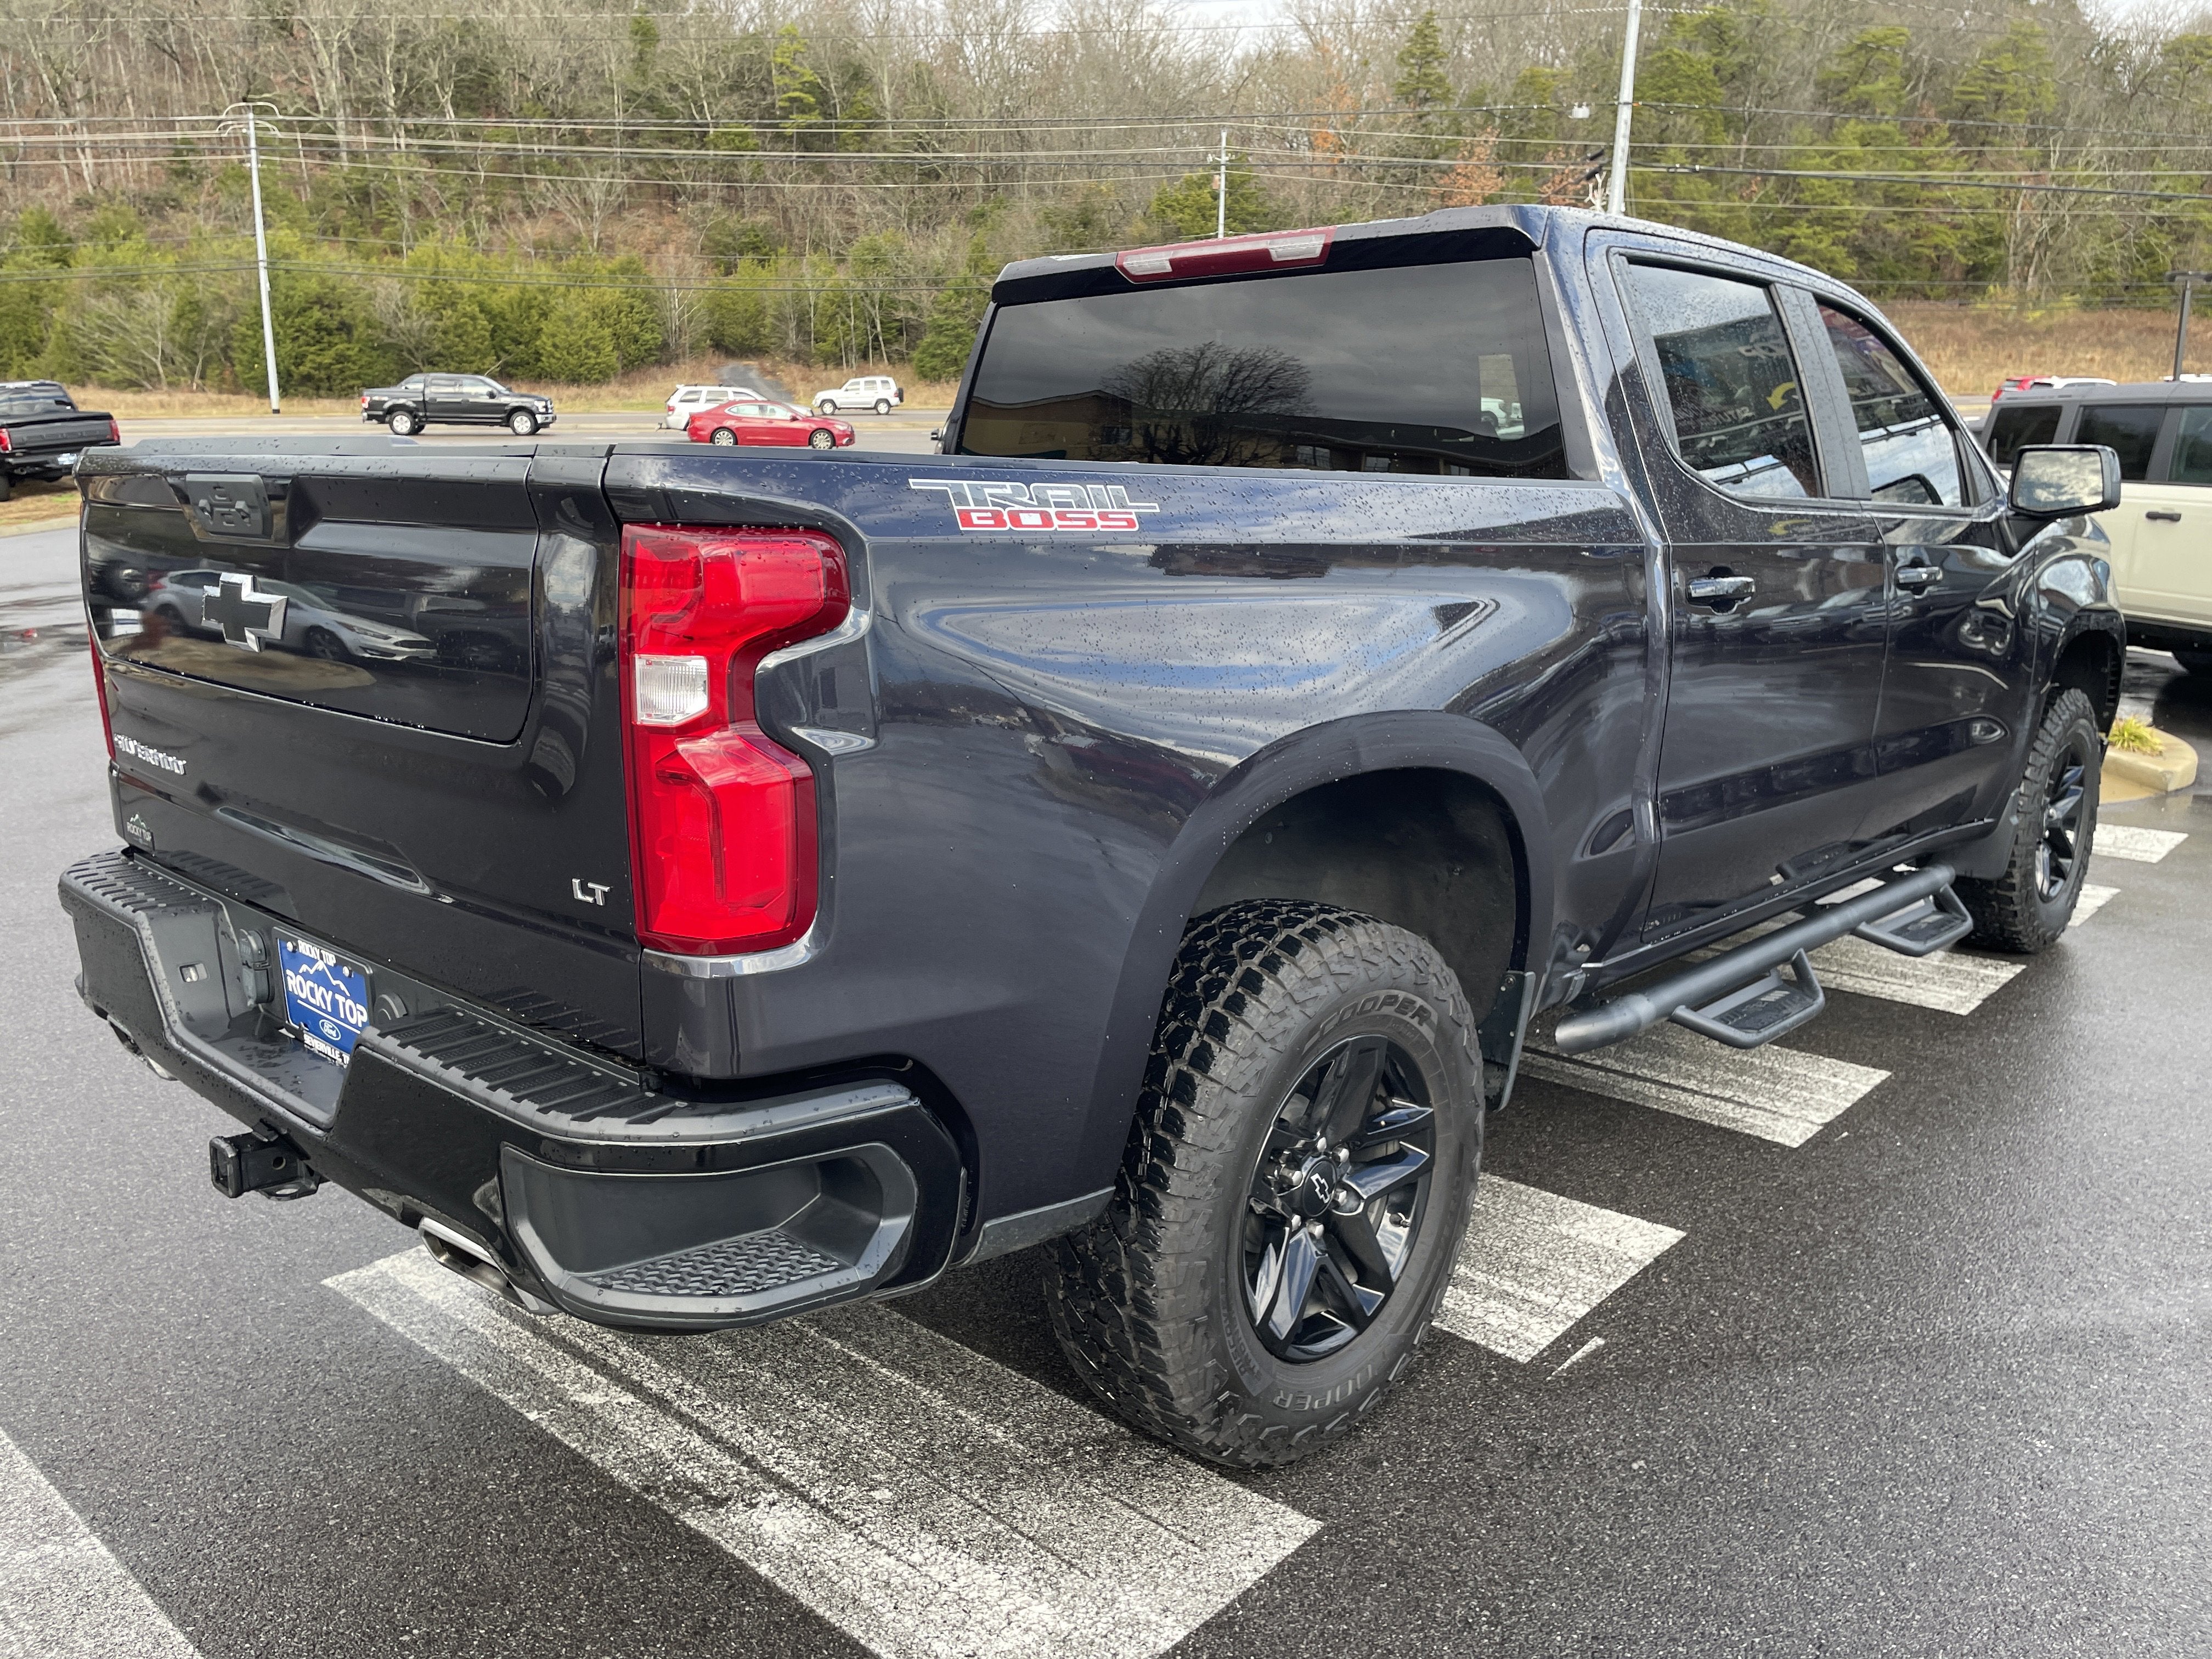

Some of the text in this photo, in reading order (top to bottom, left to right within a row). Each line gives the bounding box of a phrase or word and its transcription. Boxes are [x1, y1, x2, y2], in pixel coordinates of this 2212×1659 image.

[908, 477, 1160, 513] TRAIL
[955, 506, 1140, 531] BOSS
[572, 878, 611, 906] LT
[297, 939, 336, 967] ROCKY TOP
[286, 969, 368, 1028] ROCKY TOP
[1319, 994, 1432, 1037] COOPER
